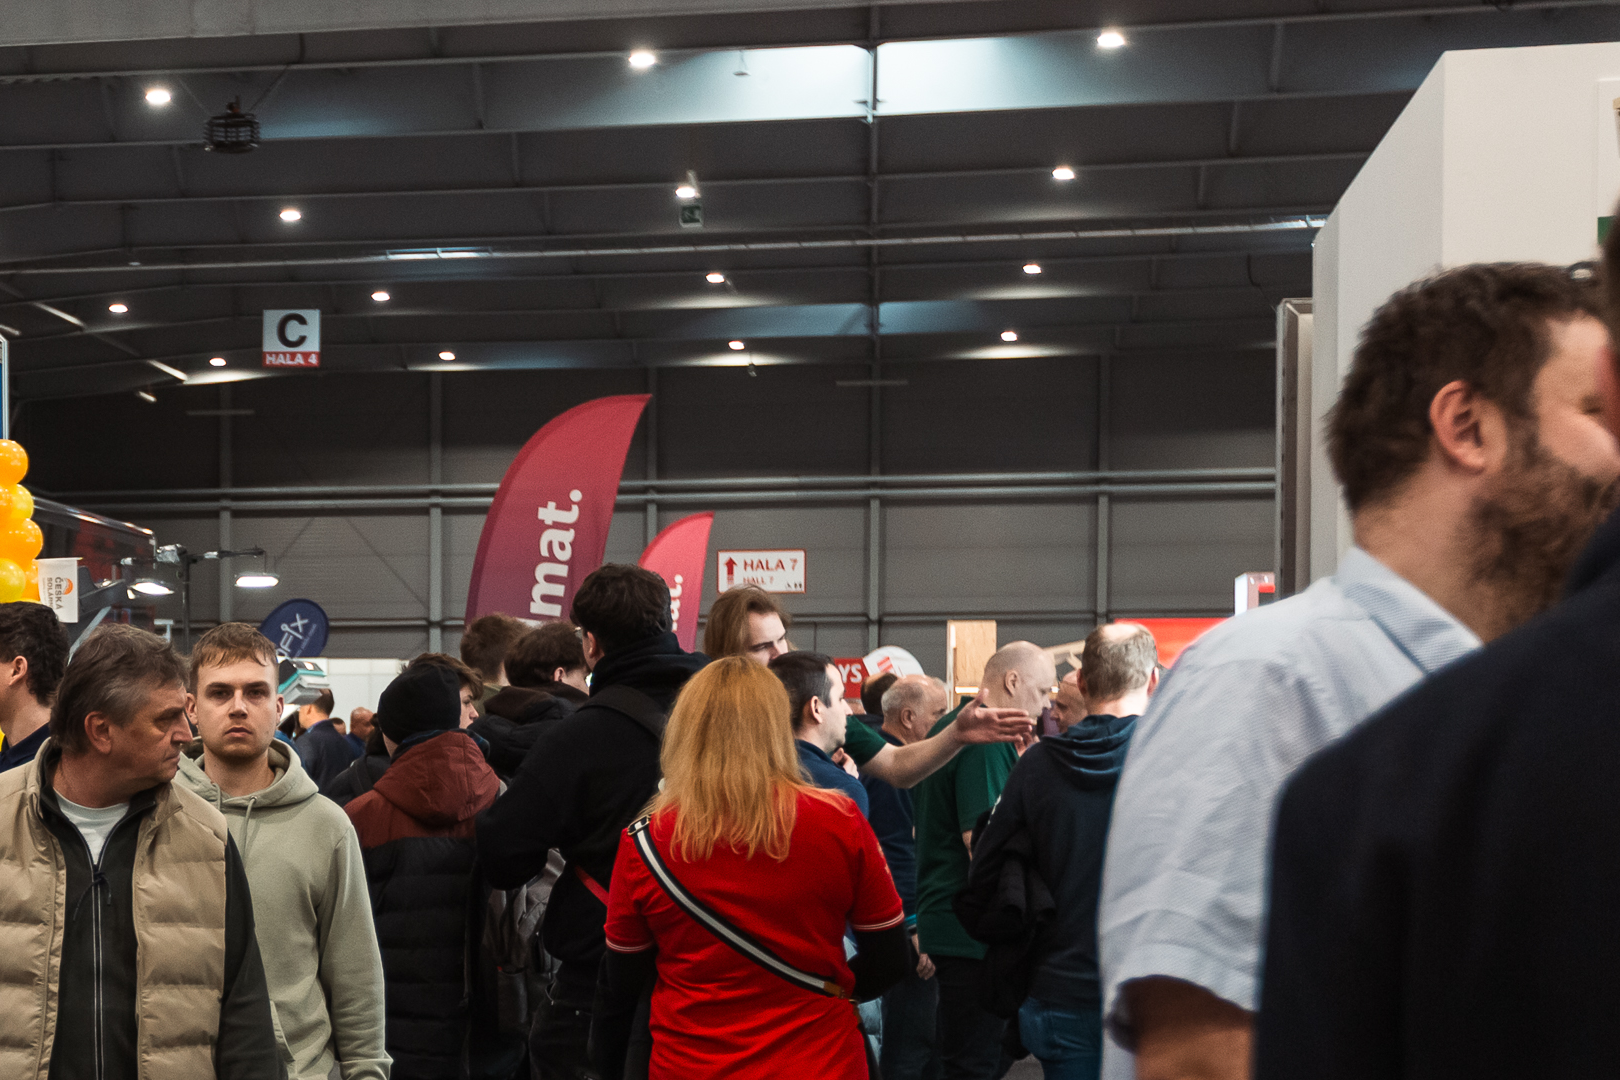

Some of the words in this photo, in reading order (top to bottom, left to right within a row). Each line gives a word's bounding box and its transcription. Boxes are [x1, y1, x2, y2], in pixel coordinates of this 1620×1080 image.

[277, 313, 308, 348] C
[266, 354, 304, 365] HALA
[308, 354, 318, 365] 4
[515, 489, 583, 628] mat.
[743, 558, 785, 571] HALA
[790, 558, 798, 571] 7
[46, 577, 54, 607] SOLÁRN
[55, 577, 64, 610] ČESKÁ
